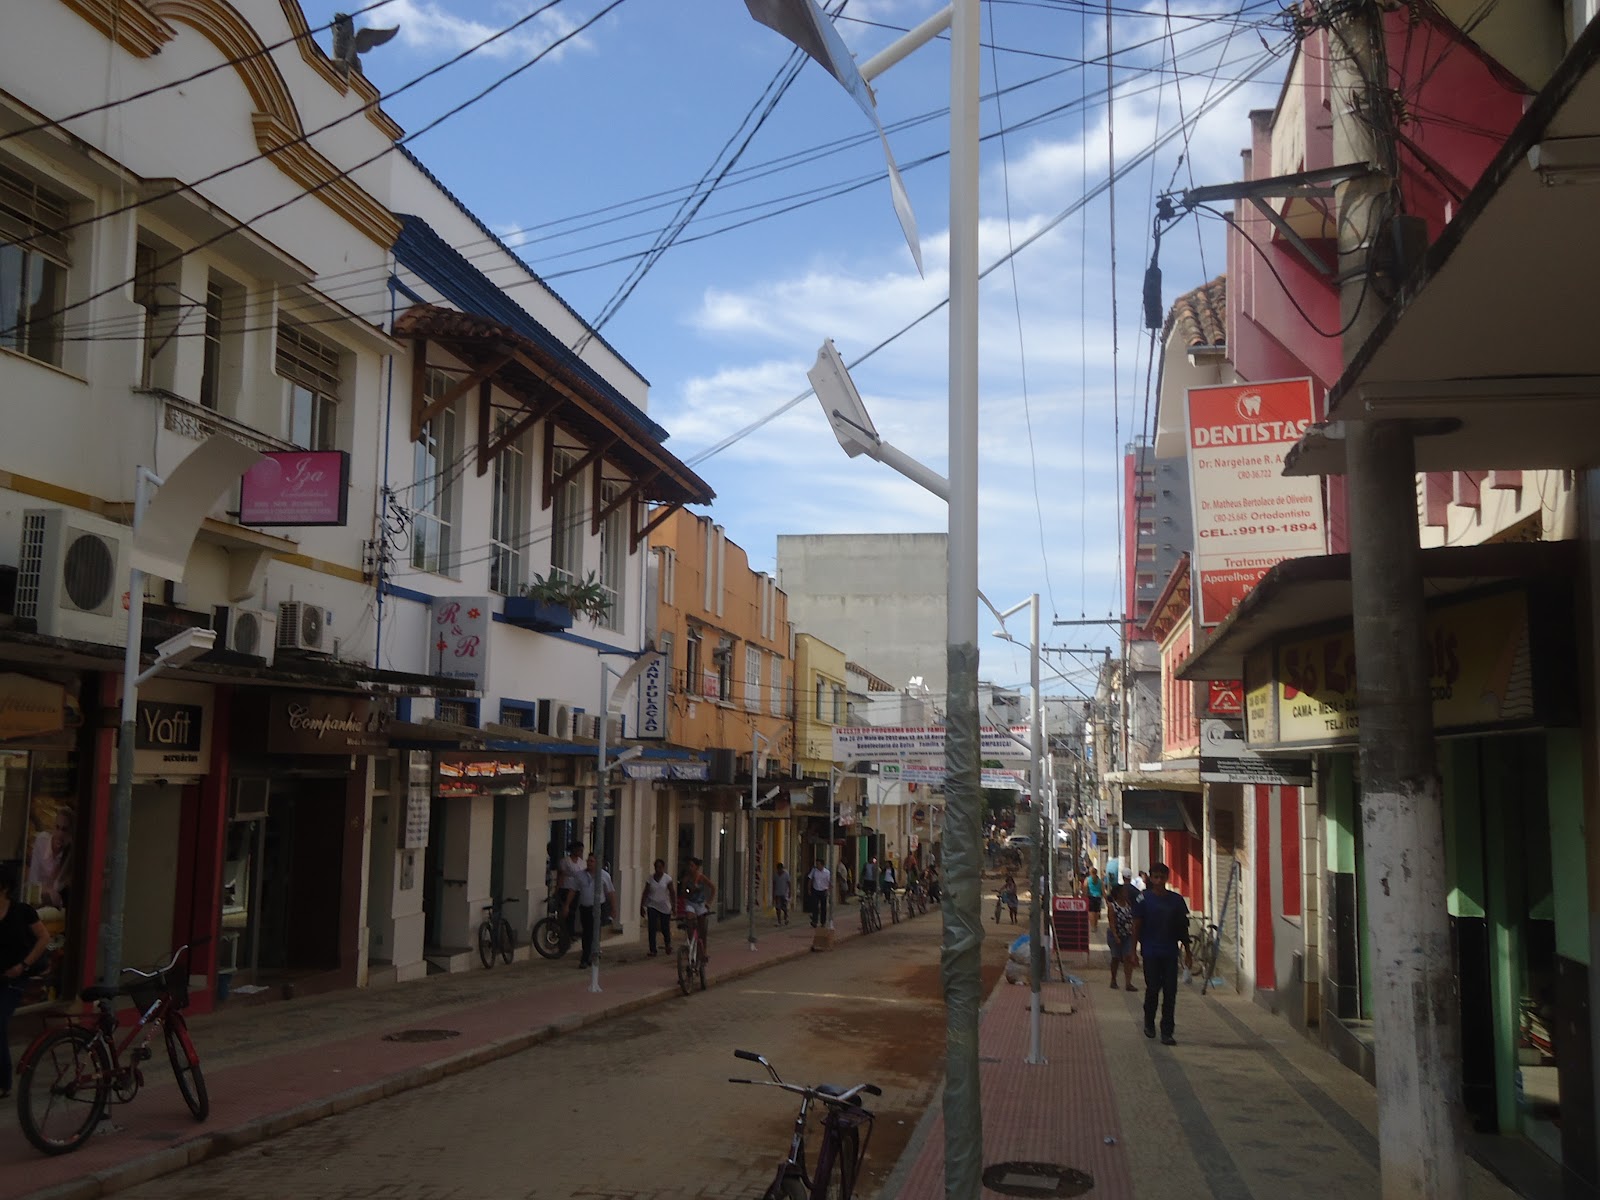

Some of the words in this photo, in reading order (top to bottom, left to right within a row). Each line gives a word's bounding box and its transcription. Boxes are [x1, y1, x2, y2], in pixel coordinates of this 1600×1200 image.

[1194, 419, 1310, 446] DENTISTAS
[1250, 510, 1311, 521] Ortodontista
[1203, 572, 1255, 585] Aparelhos
[1292, 704, 1313, 718] CAMA
[1345, 698, 1359, 711] BA
[144, 707, 192, 745] Yafit
[288, 703, 362, 740] Companhia
